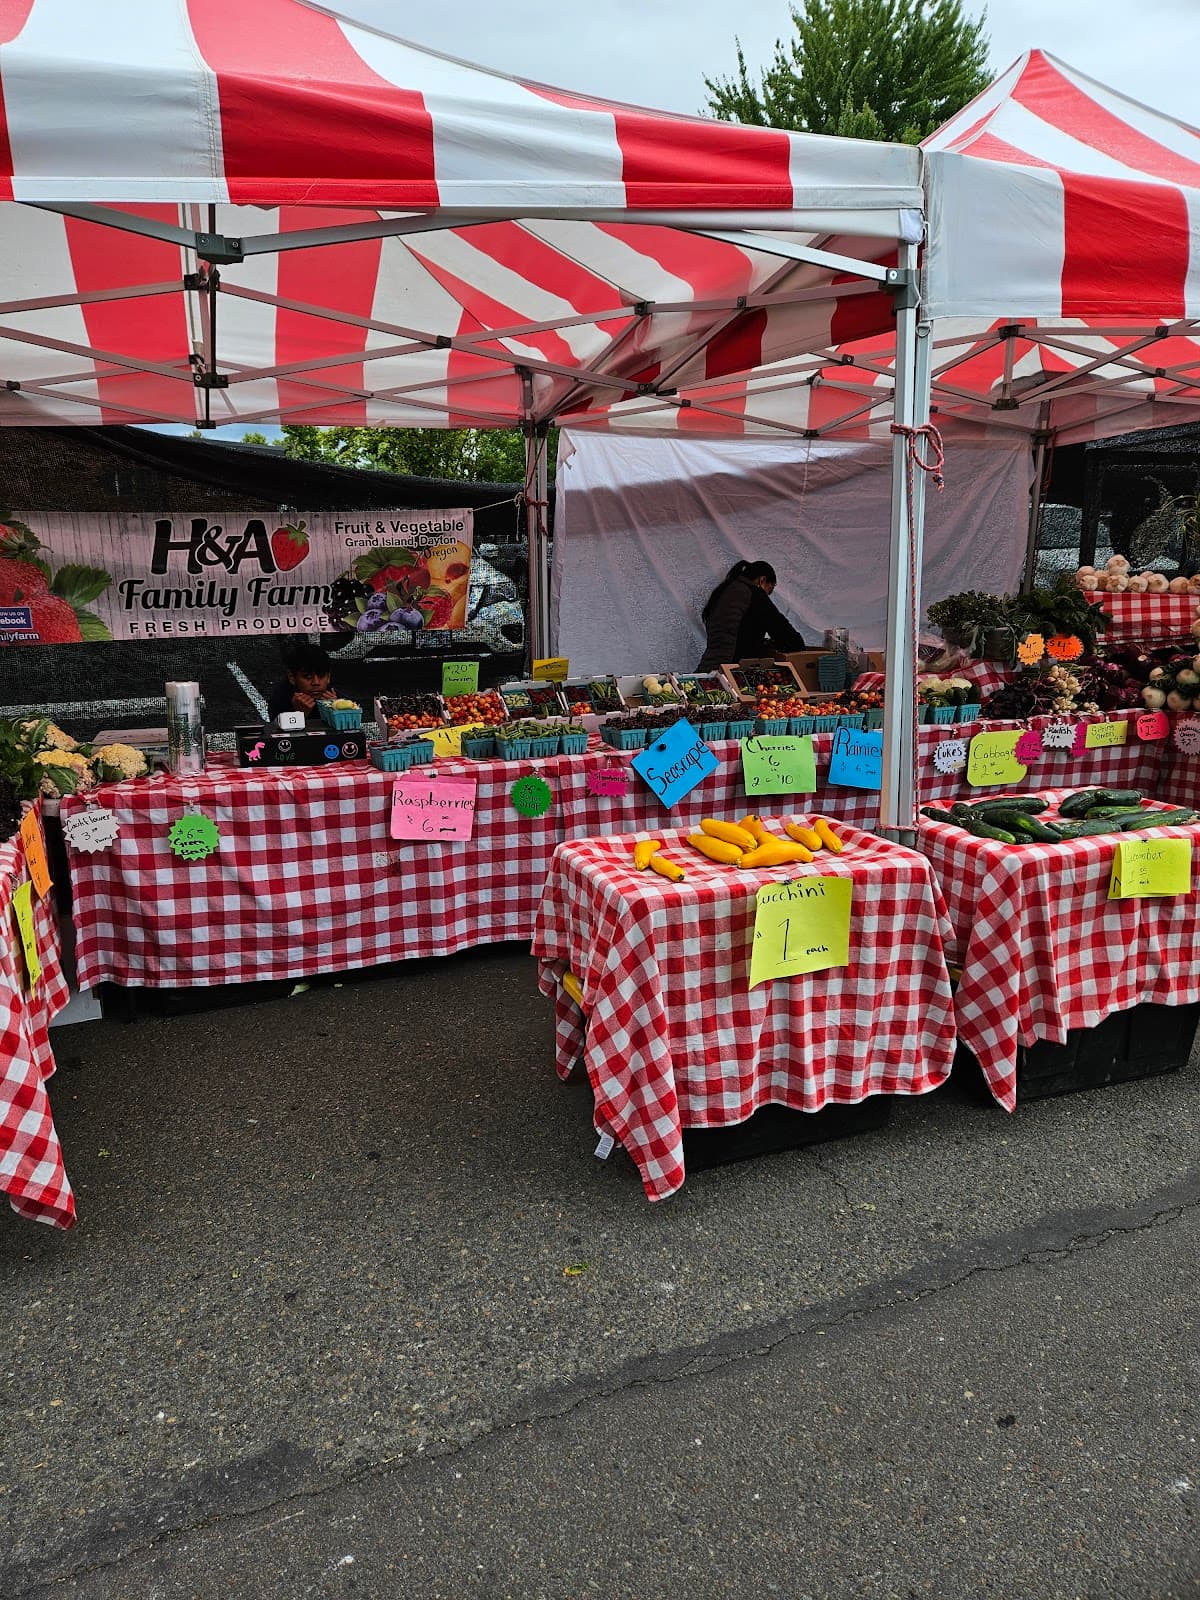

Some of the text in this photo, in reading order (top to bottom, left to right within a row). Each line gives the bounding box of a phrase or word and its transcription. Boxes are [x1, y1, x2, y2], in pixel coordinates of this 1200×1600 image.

[334, 519, 464, 535] Fruit & Vegetable
[151, 518, 277, 574] H&A
[345, 535, 456, 548] Grand Island, Dayton
[424, 546, 458, 560] Oregon
[118, 577, 332, 617] Family Farm
[130, 616, 330, 634] FRESH PRODUCE
[745, 739, 796, 753] Cherries
[836, 727, 882, 758] Rainie
[646, 740, 711, 796] Seascape
[393, 789, 475, 811] Raspberries
[806, 944, 829, 955] each
